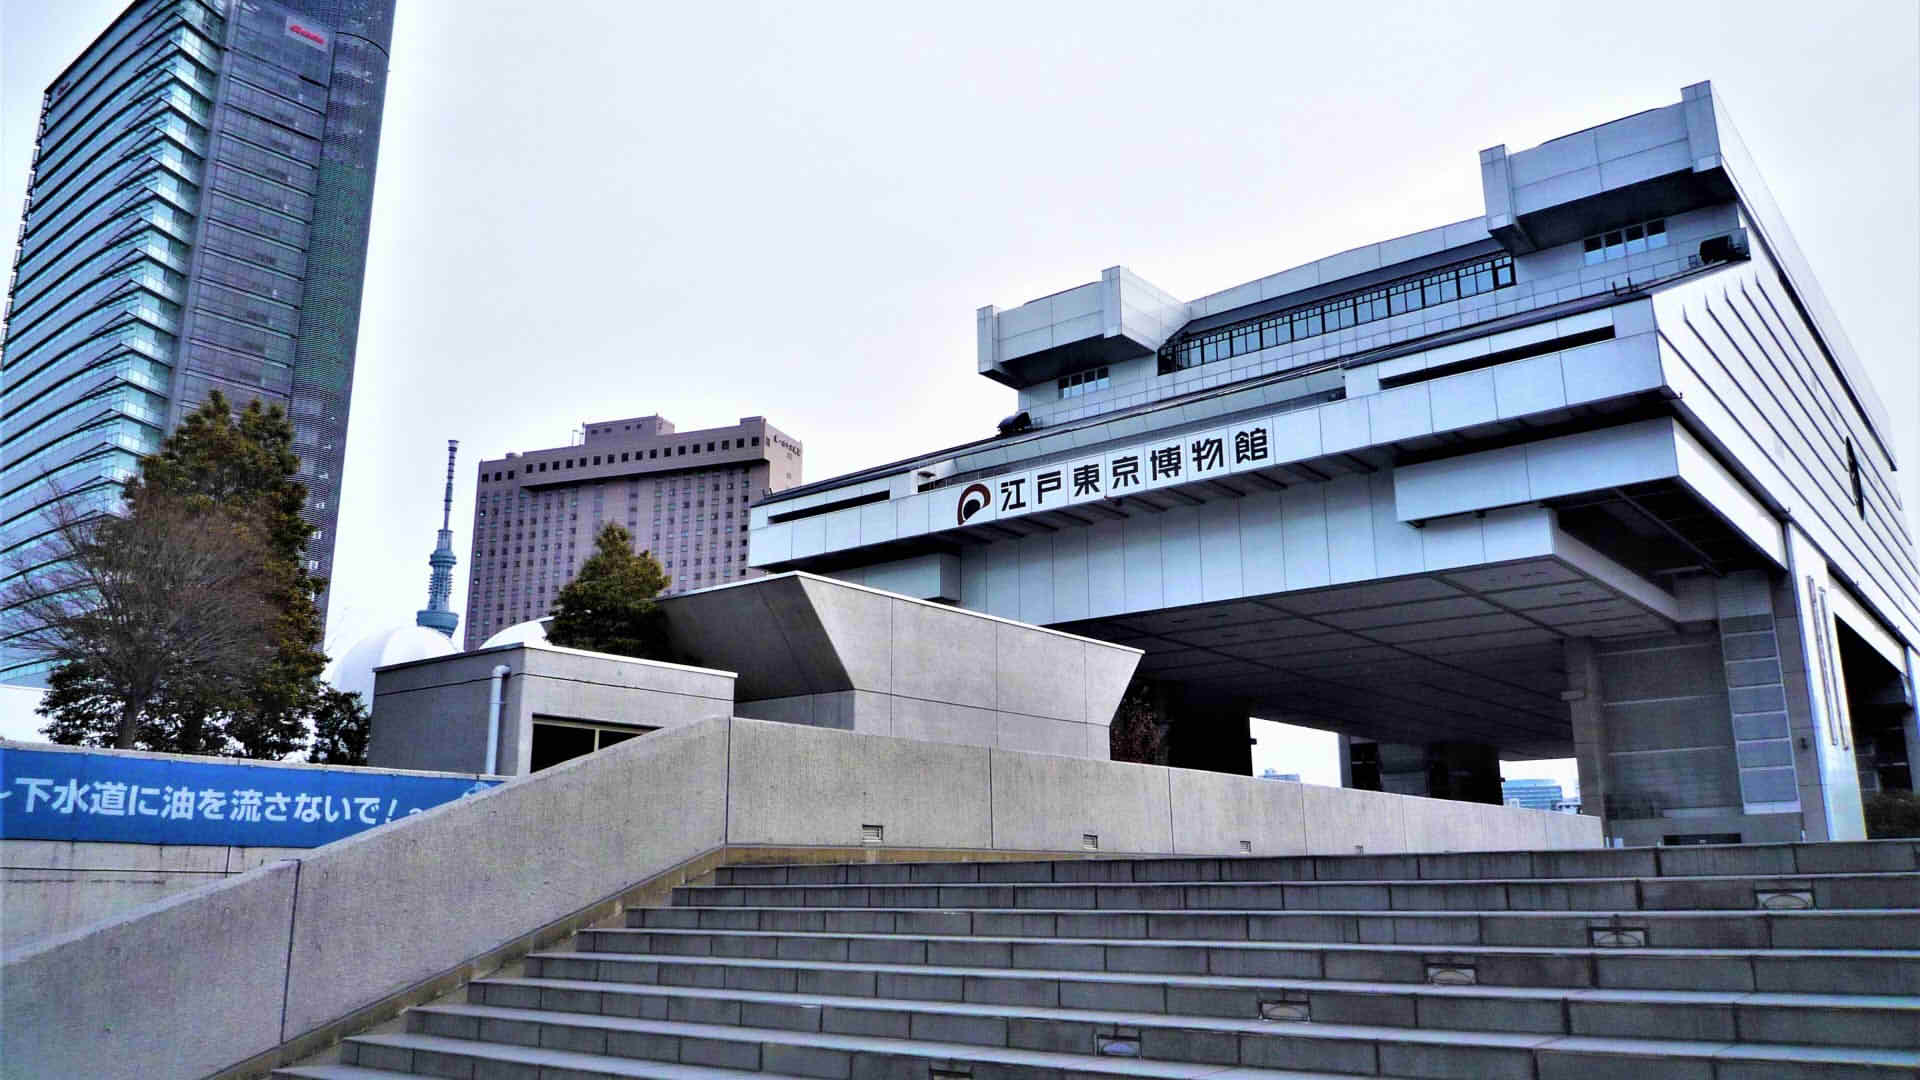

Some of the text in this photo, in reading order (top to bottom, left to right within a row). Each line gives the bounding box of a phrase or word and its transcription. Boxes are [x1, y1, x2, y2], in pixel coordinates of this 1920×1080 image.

[1001, 428, 1268, 511] 江戸東京博物館
